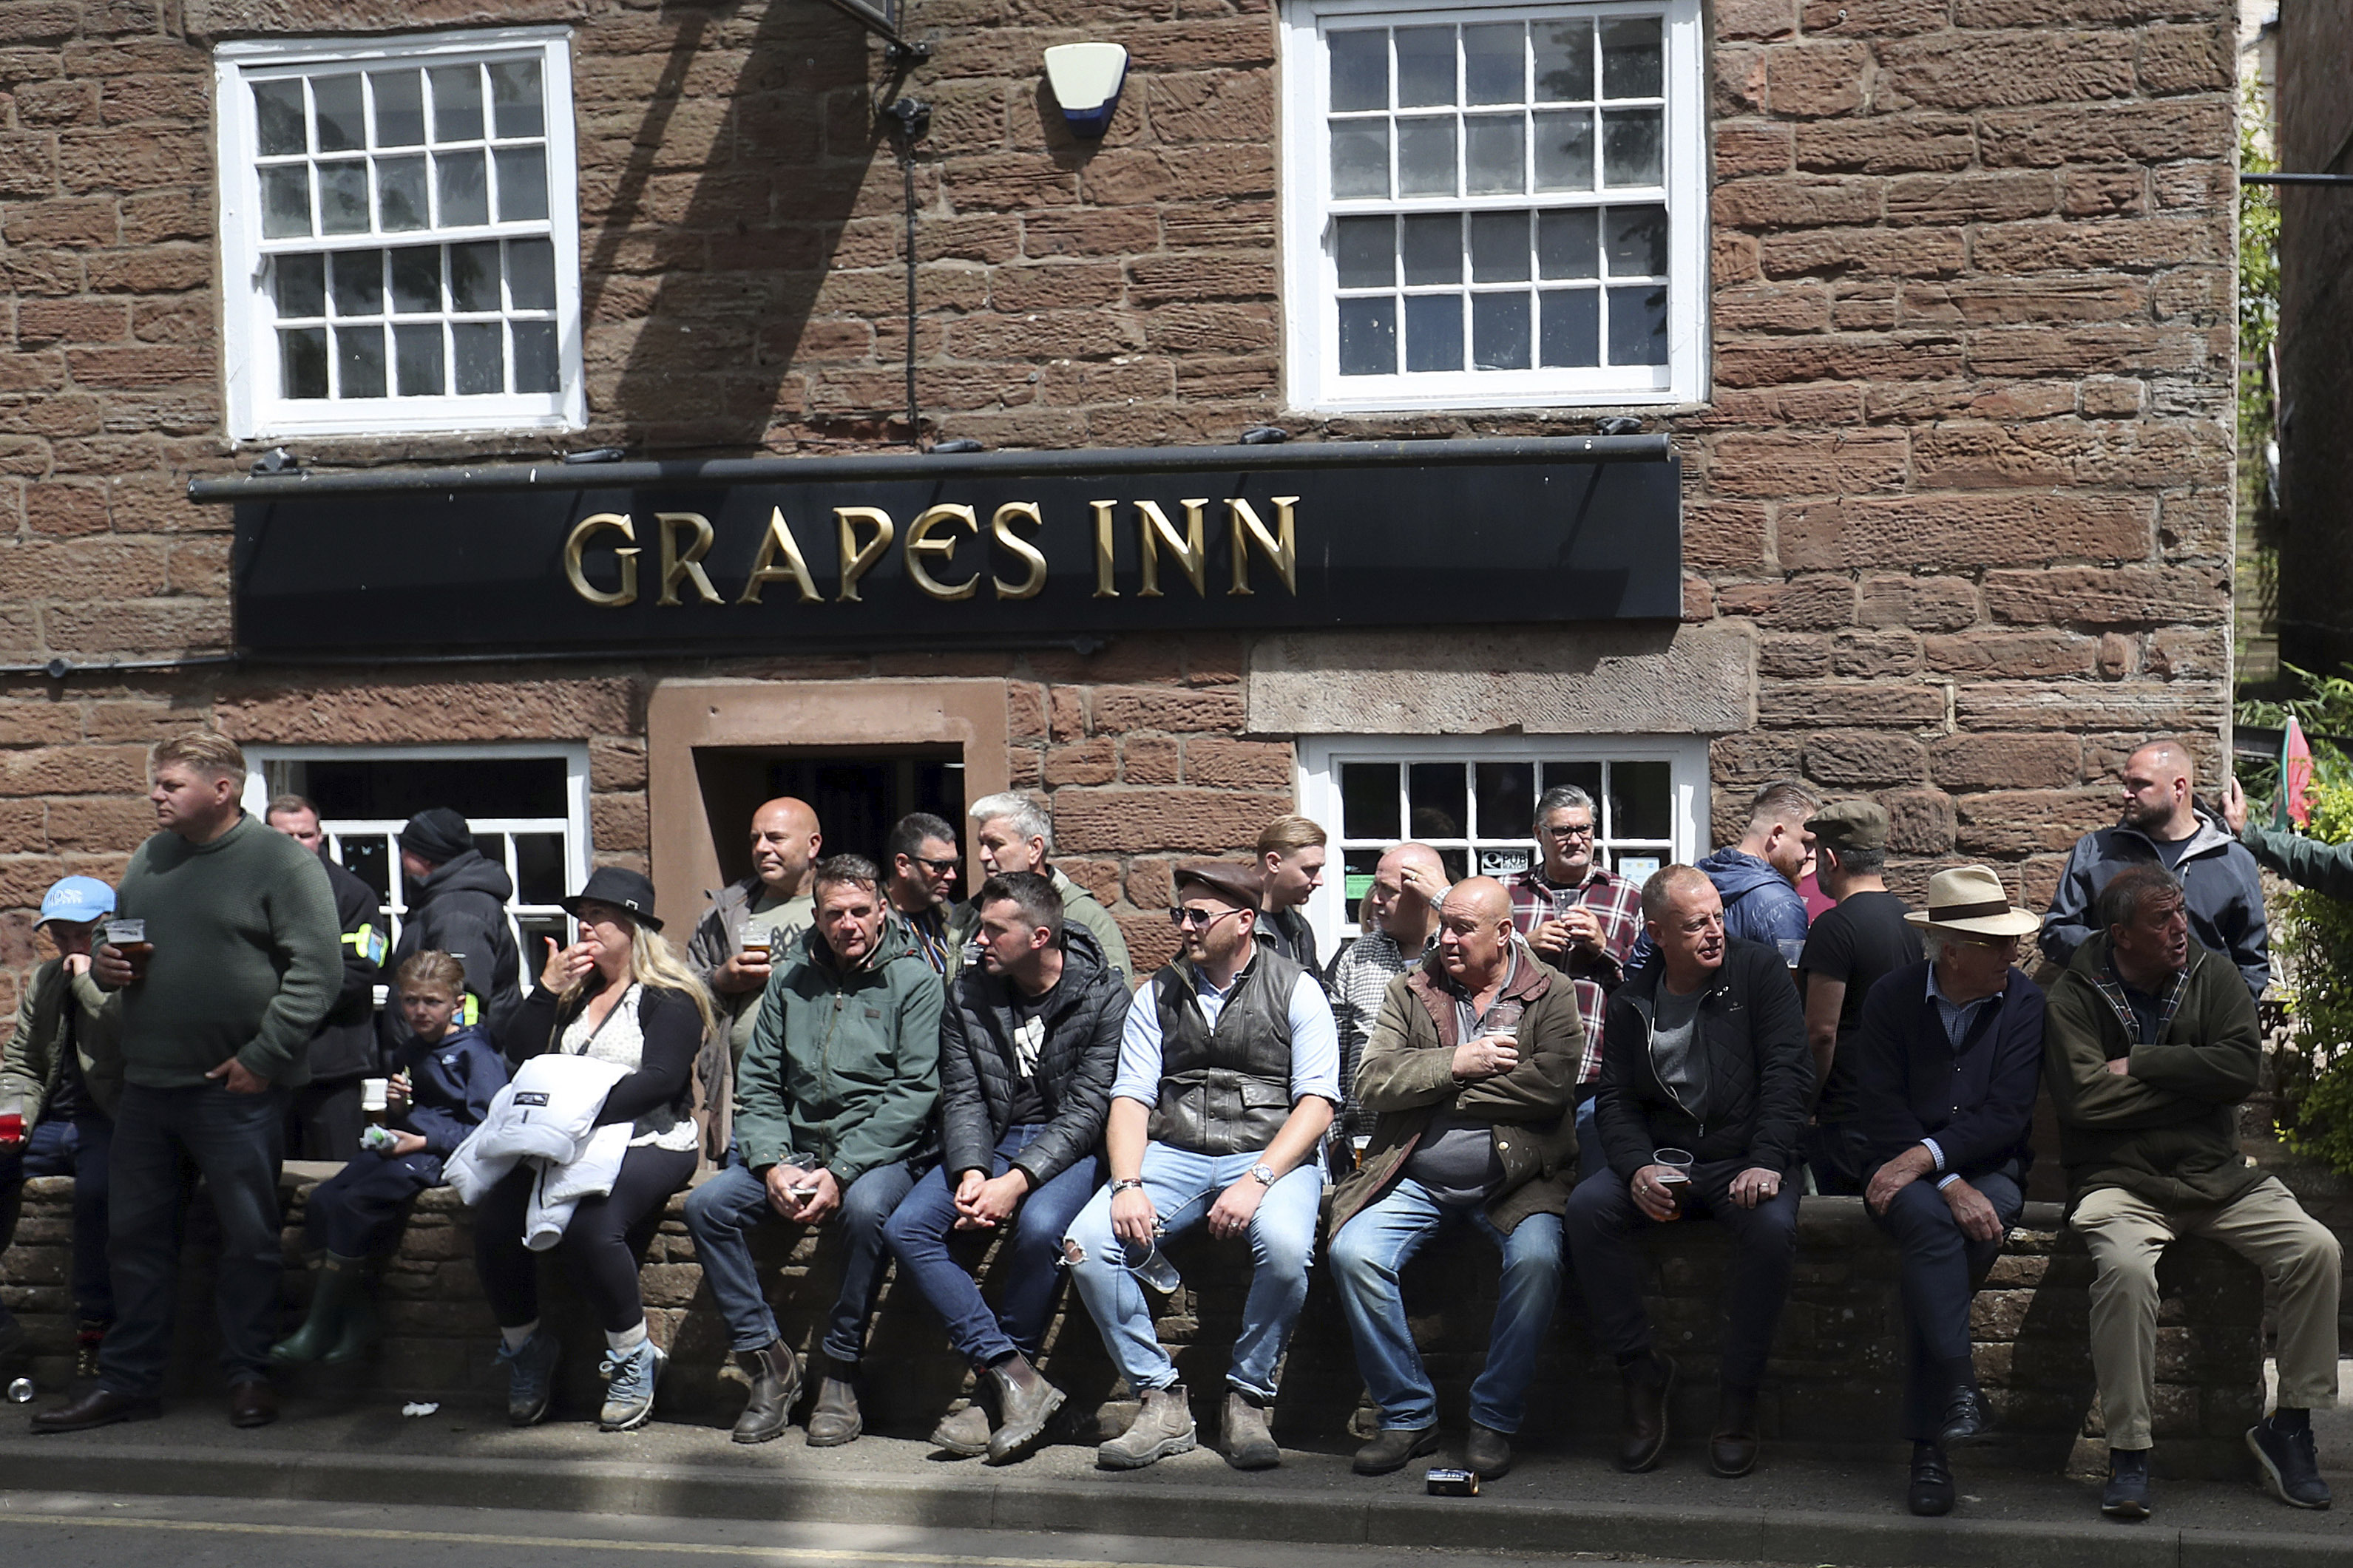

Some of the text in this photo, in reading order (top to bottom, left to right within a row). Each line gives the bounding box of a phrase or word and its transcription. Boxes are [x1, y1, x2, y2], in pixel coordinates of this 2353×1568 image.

[564, 496, 1301, 606] GRAPES INN
[1503, 854, 1527, 865] PUB
